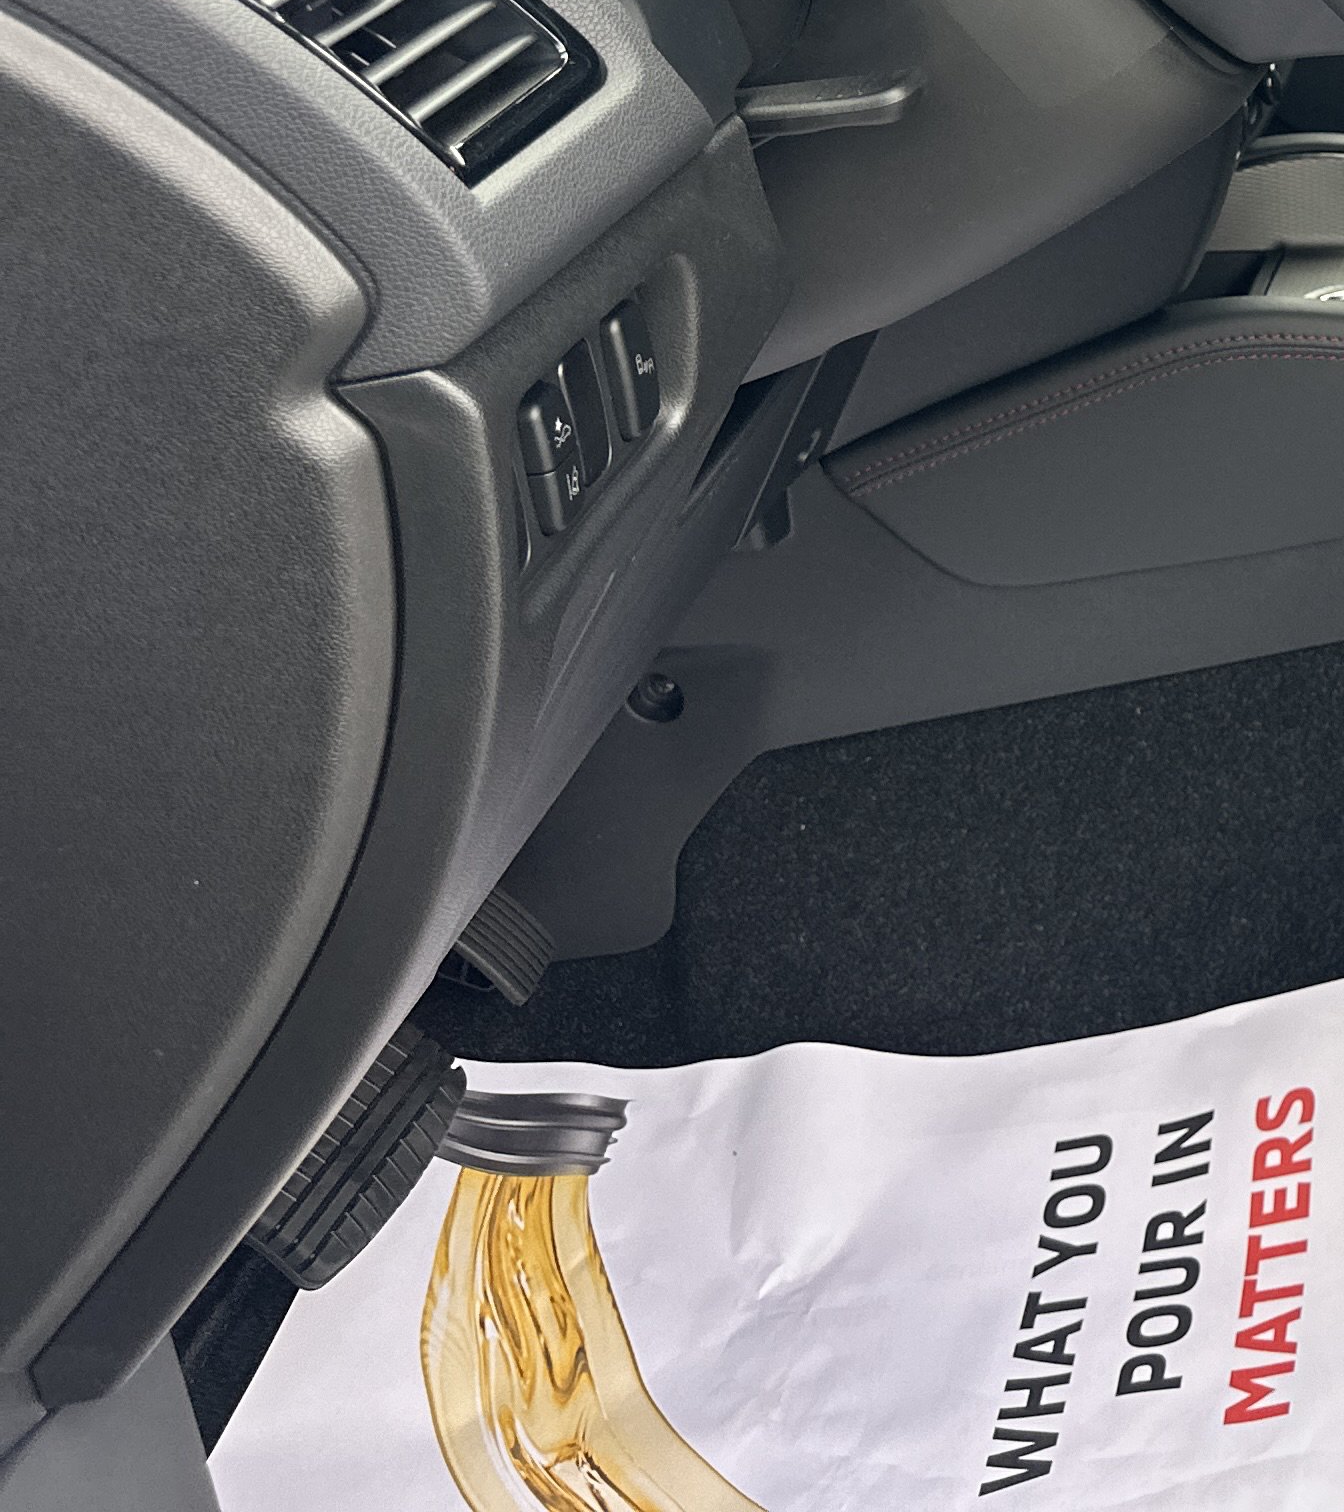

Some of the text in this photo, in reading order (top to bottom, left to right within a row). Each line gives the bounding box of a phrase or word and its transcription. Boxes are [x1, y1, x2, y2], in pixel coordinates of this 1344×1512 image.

[979, 1135, 1112, 1496] WHAT YOU
[1116, 1111, 1213, 1396] POUR IN
[1224, 1089, 1314, 1424] MATTERS
